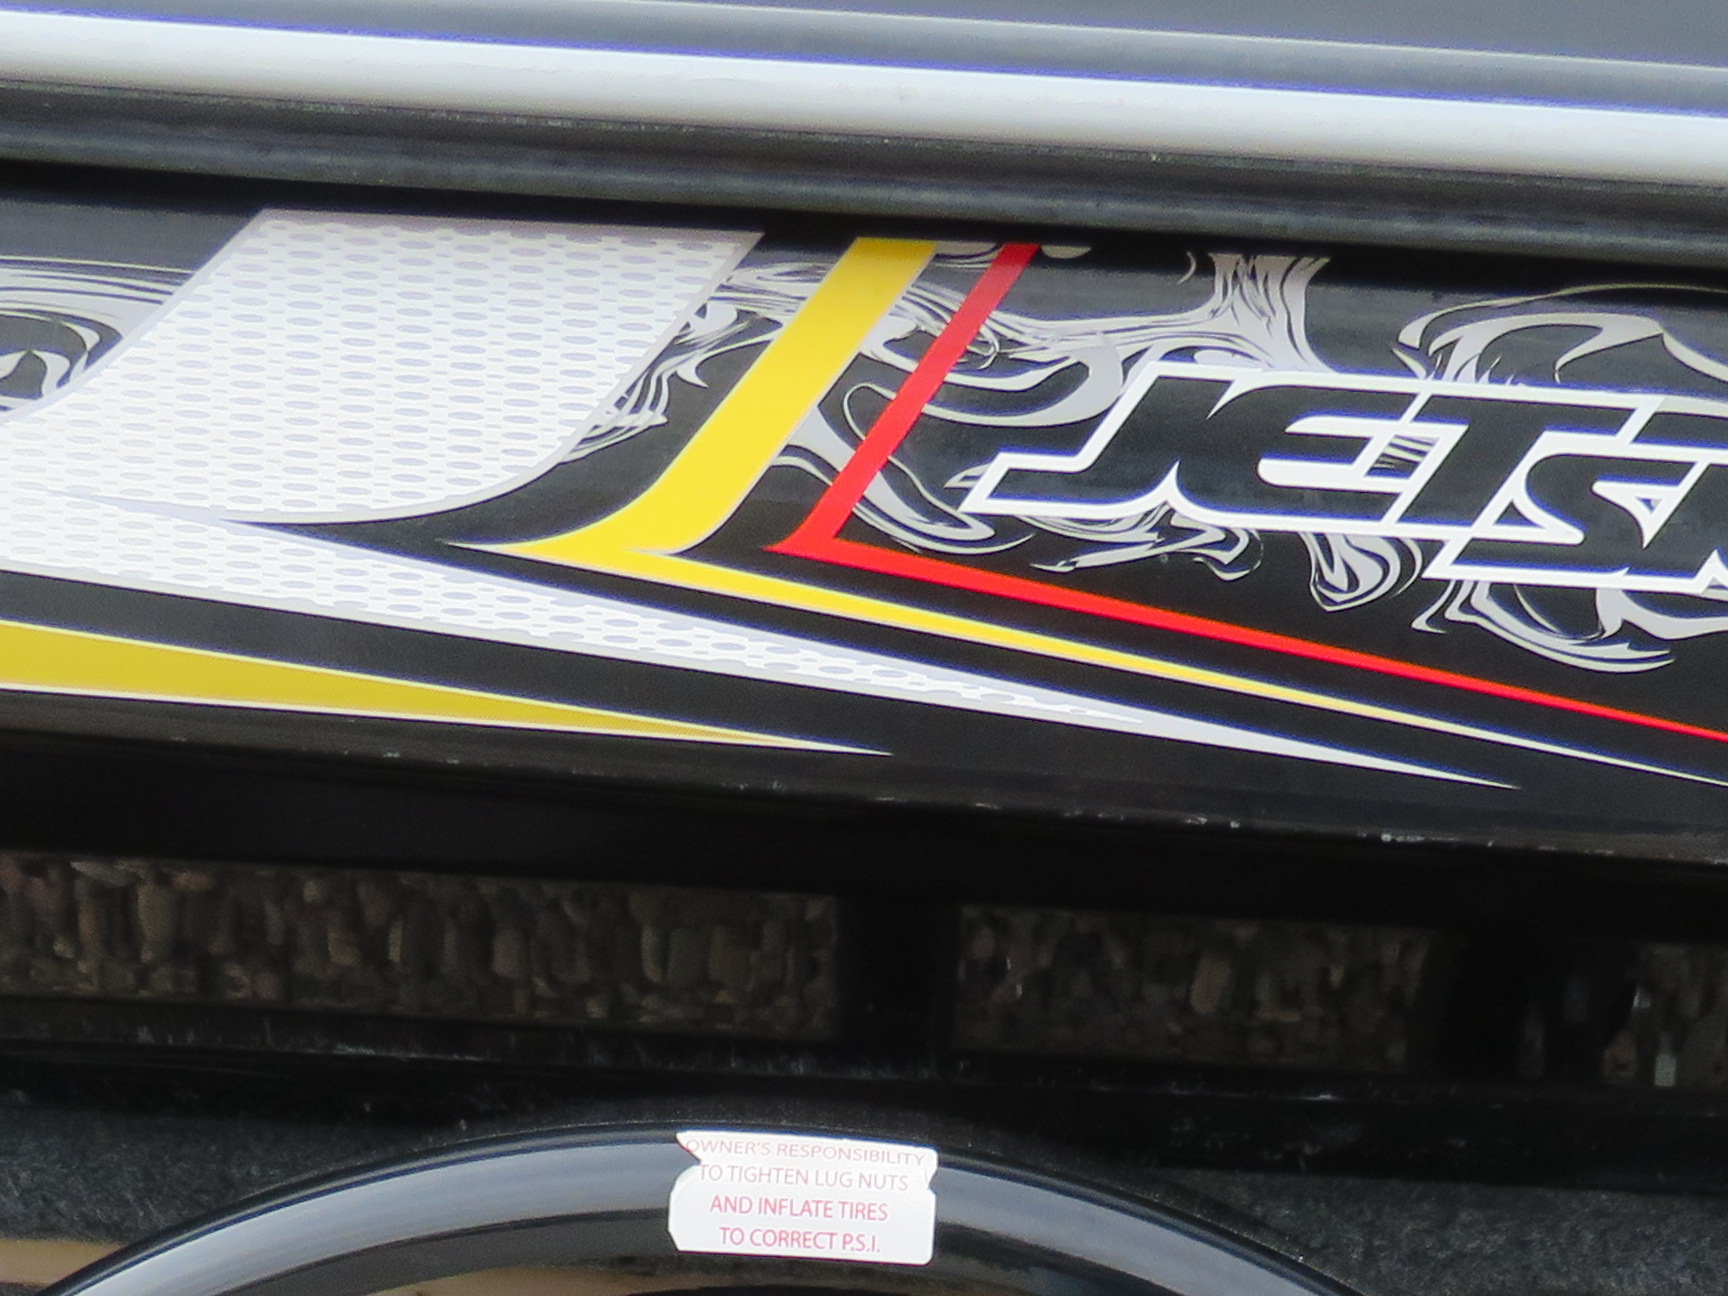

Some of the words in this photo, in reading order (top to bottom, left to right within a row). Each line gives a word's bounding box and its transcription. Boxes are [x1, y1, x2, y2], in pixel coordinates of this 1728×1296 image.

[685, 1138, 771, 1156] OWNER'S
[776, 1143, 925, 1167] RESPONSIBILITY
[699, 1164, 723, 1181] TO
[727, 1165, 809, 1186] TIGHTEN
[814, 1170, 853, 1188] LUG
[858, 1173, 908, 1191] NUTS
[710, 1195, 753, 1214] AND
[758, 1197, 833, 1219] INFLATE
[835, 1201, 888, 1221] TIRES
[719, 1226, 744, 1245] TO
[749, 1228, 838, 1249] CORRECT
[841, 1233, 881, 1253] P.S.I.
